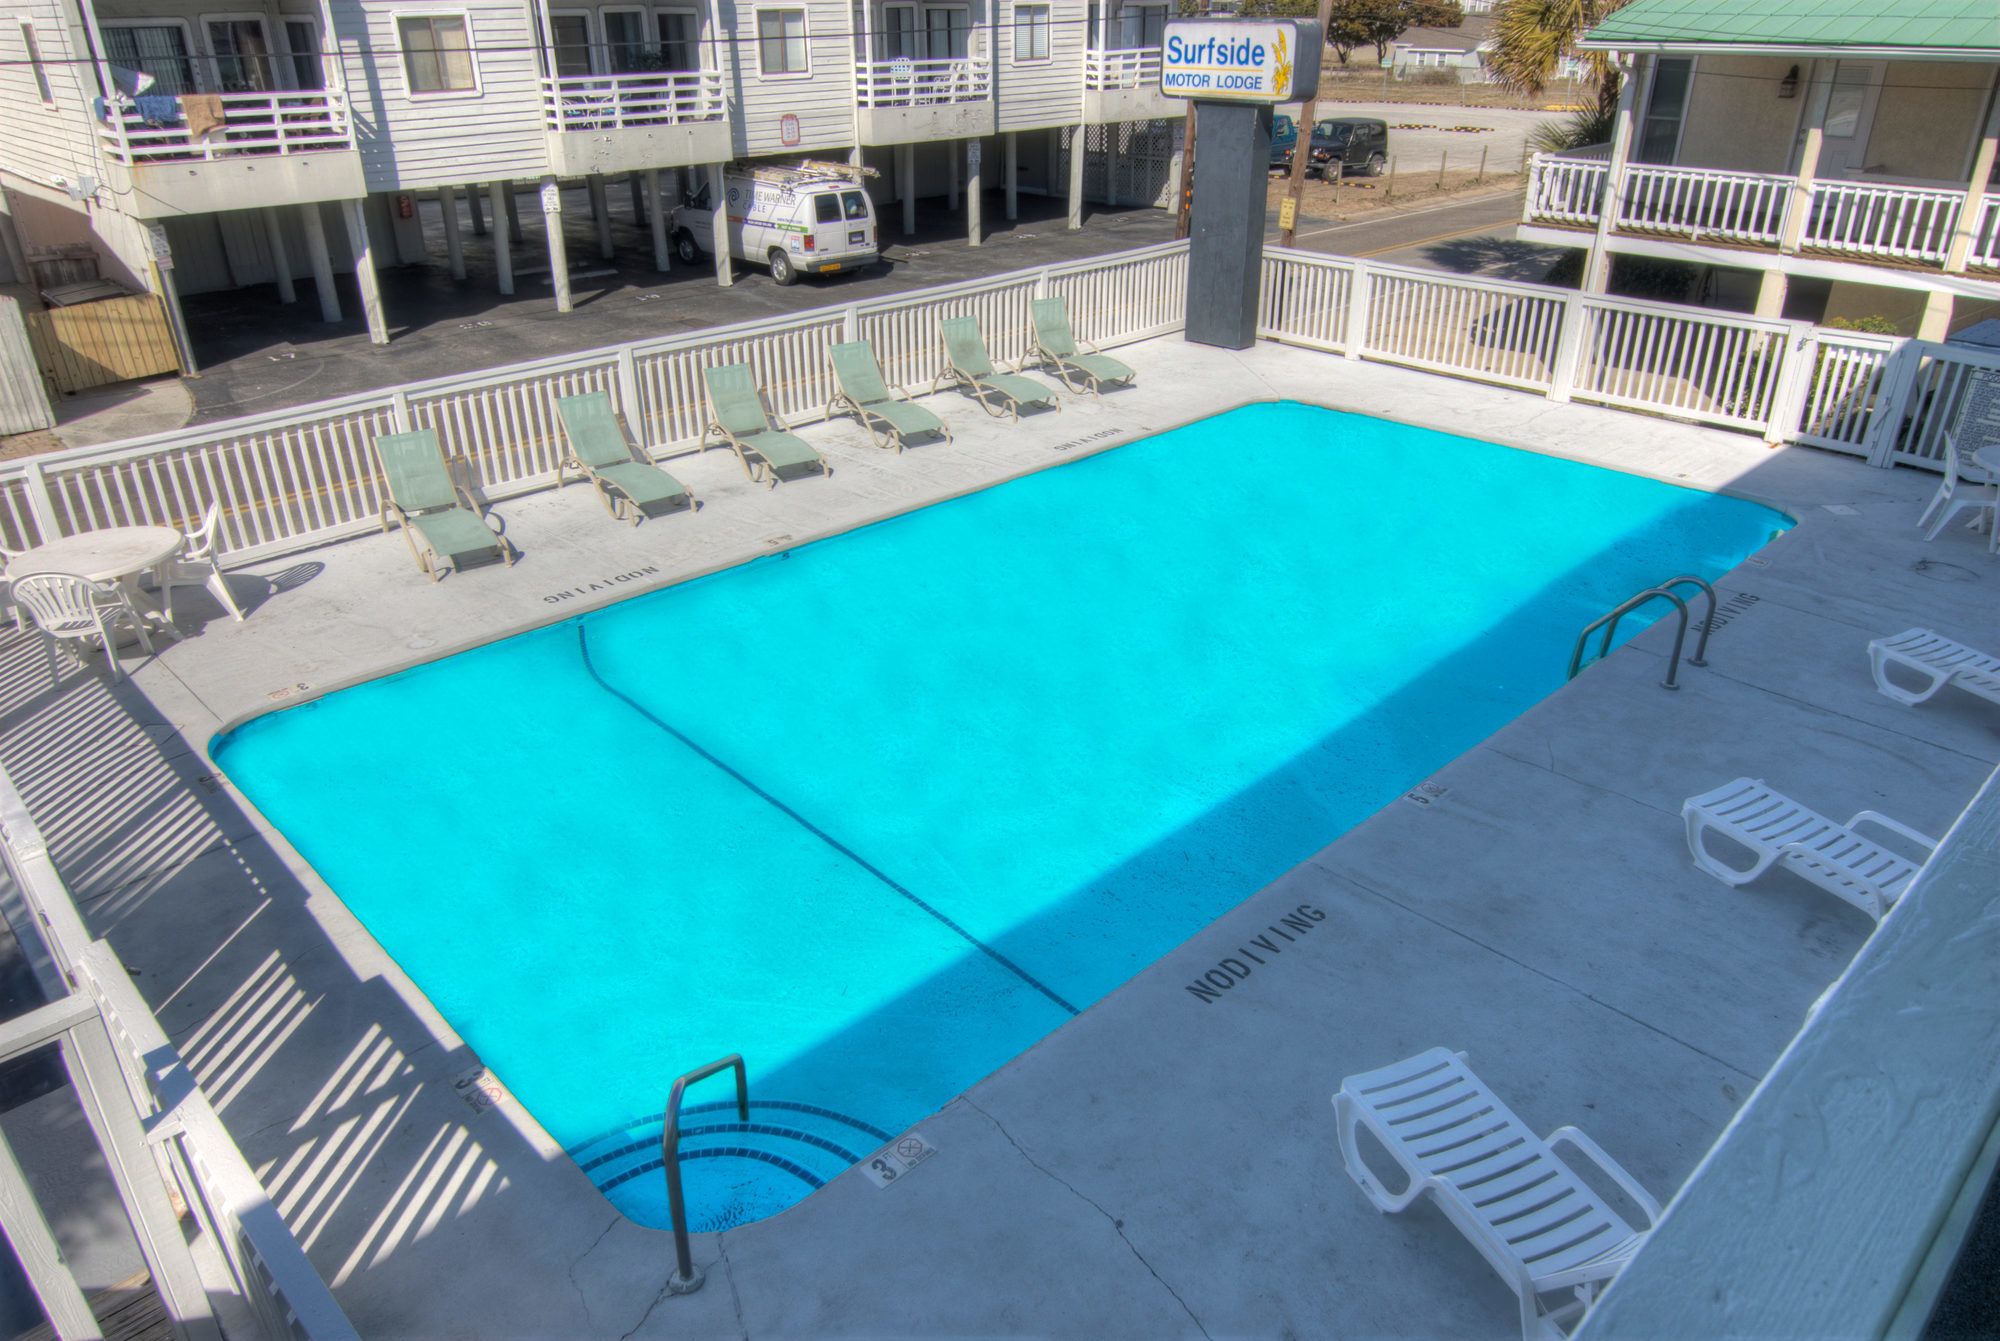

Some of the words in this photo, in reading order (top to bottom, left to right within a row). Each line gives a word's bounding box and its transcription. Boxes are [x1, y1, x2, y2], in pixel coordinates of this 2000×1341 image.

[1167, 35, 1265, 65] Surfside
[1165, 73, 1210, 88] MOTOR
[1217, 75, 1263, 90] LODGE
[764, 191, 797, 206] WARNER
[1407, 792, 1430, 805] 5
[871, 1158, 897, 1181] 3
